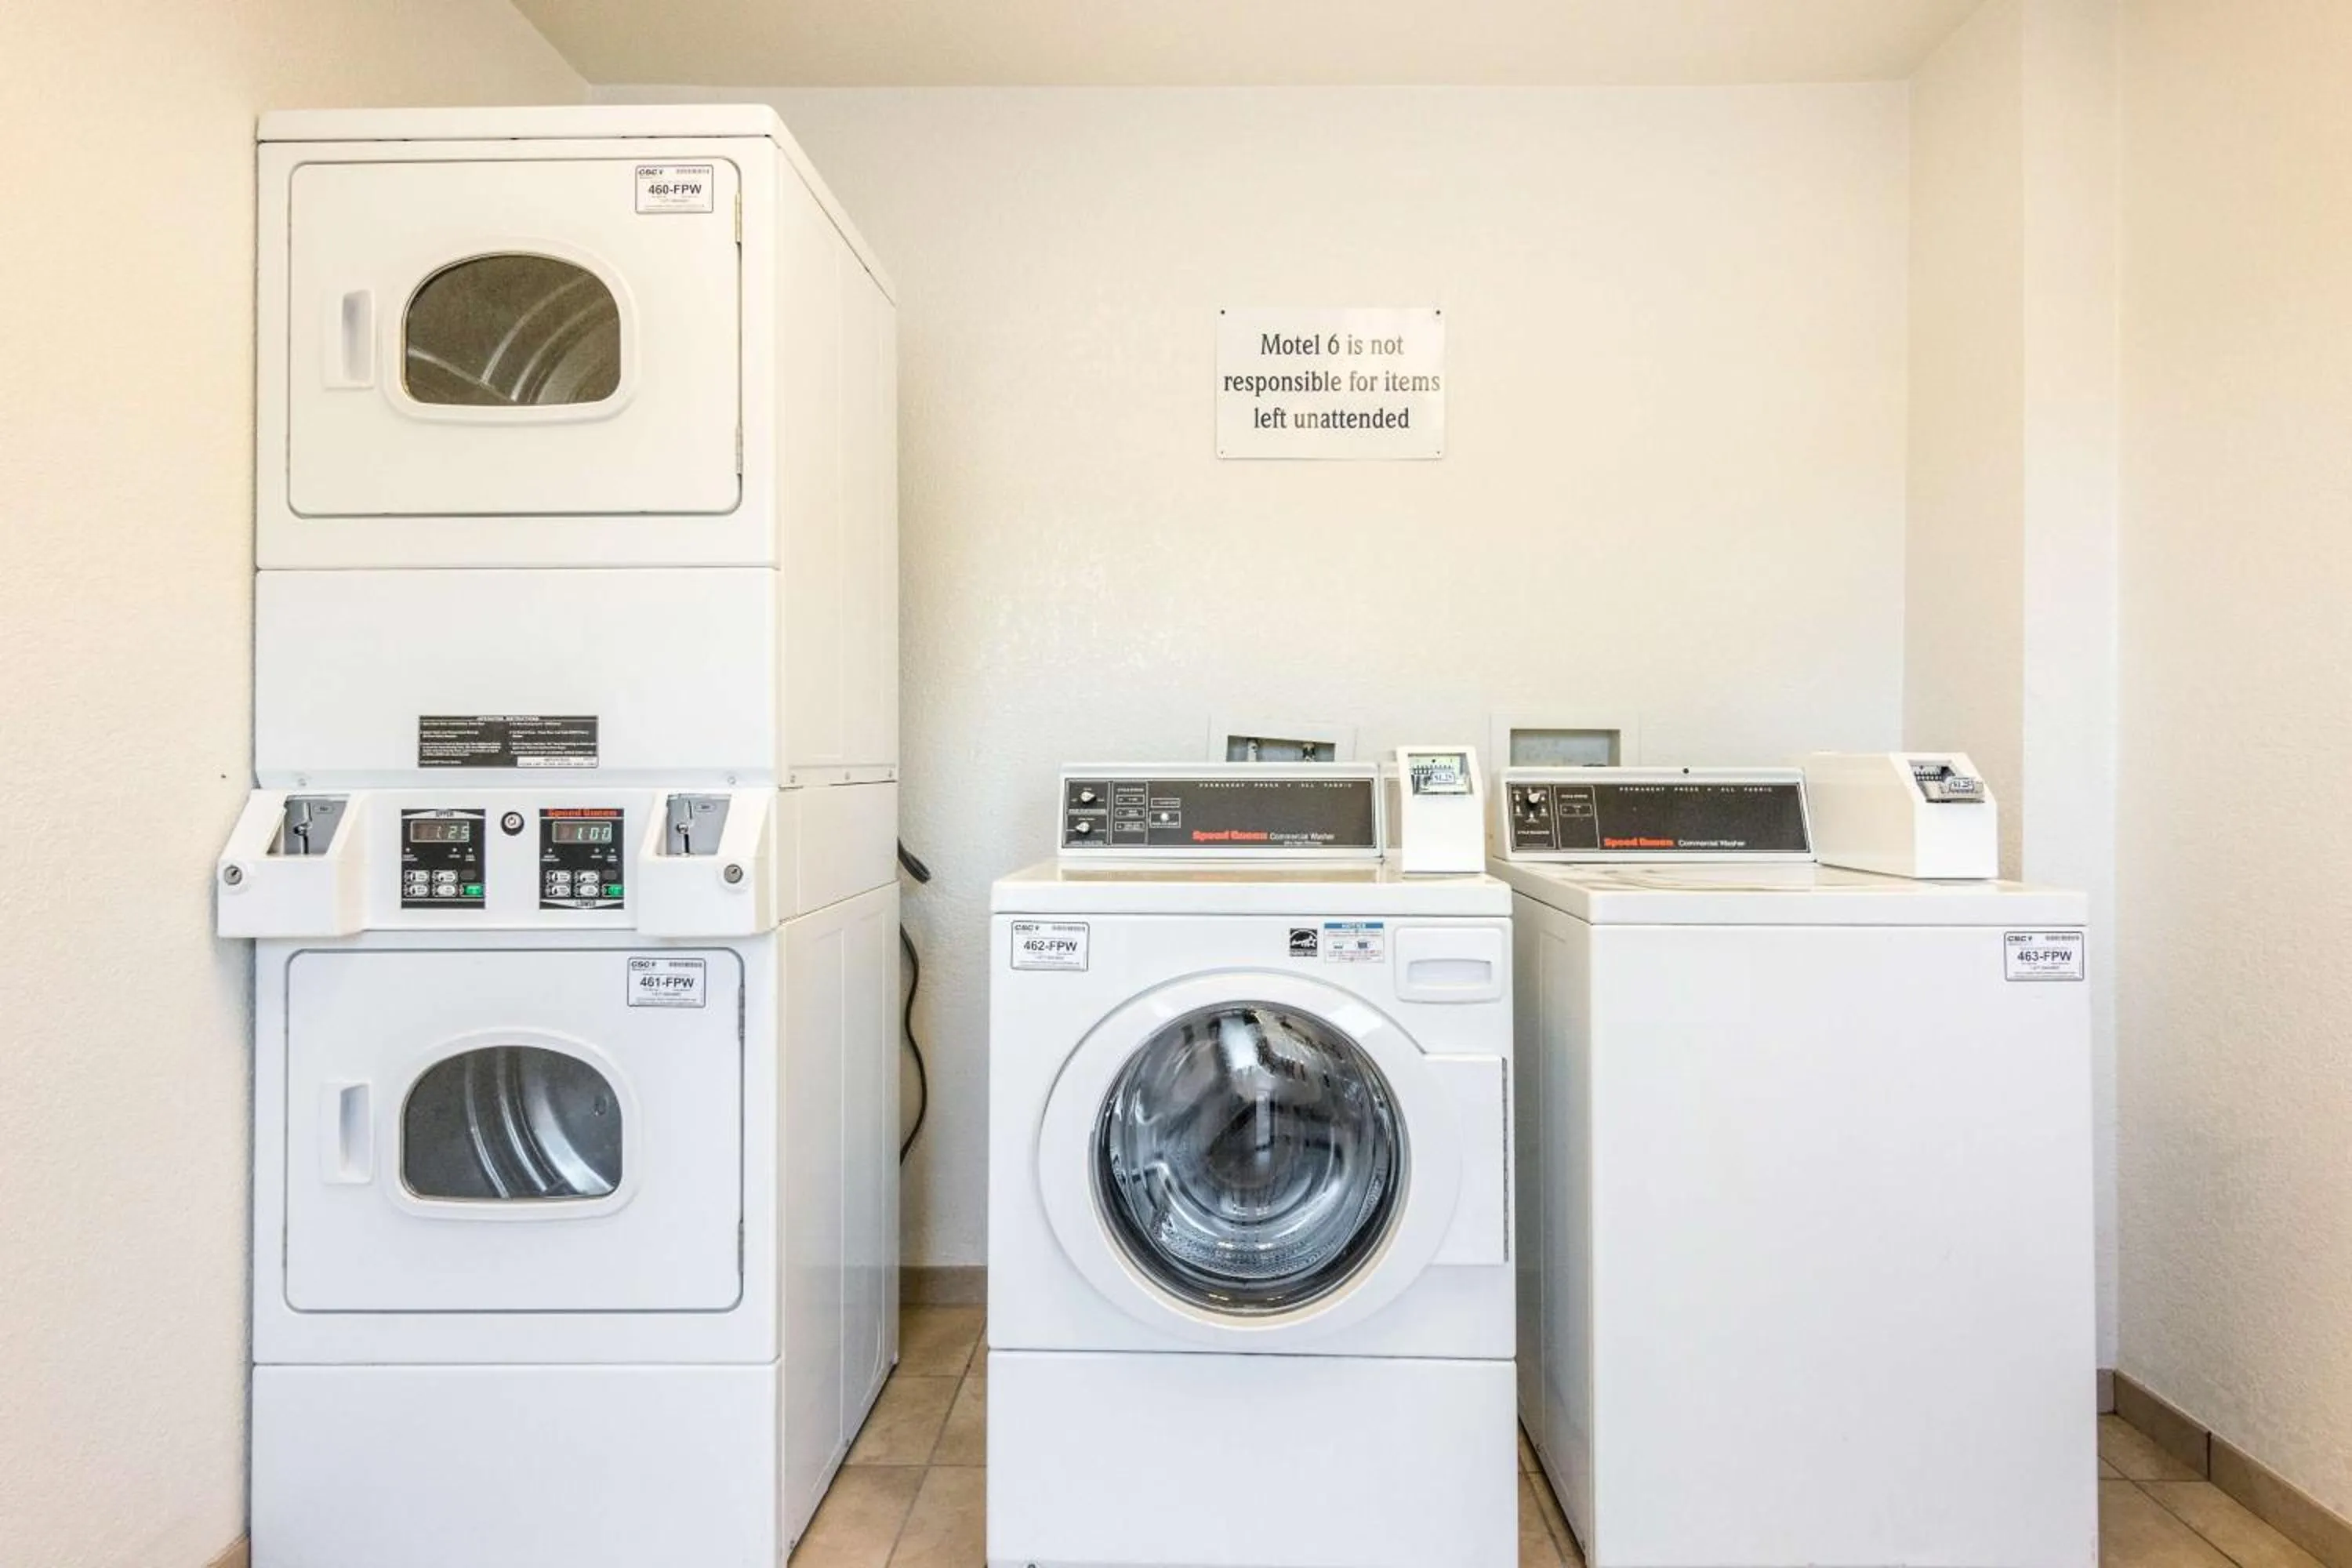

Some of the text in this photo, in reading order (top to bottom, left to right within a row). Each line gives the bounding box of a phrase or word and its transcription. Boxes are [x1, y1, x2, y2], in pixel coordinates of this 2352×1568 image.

[648, 184, 702, 194] 460-FPW
[1261, 333, 1404, 355] Motel 6 is not
[1224, 371, 1441, 397] responsible for items
[1254, 408, 1410, 429] left unattended
[1192, 831, 1229, 841] Speed
[1604, 838, 1638, 848] Speed
[1023, 941, 1078, 951] 462-FPW
[2016, 951, 2073, 962] 463-FPW
[639, 977, 695, 988] 461-FPW
